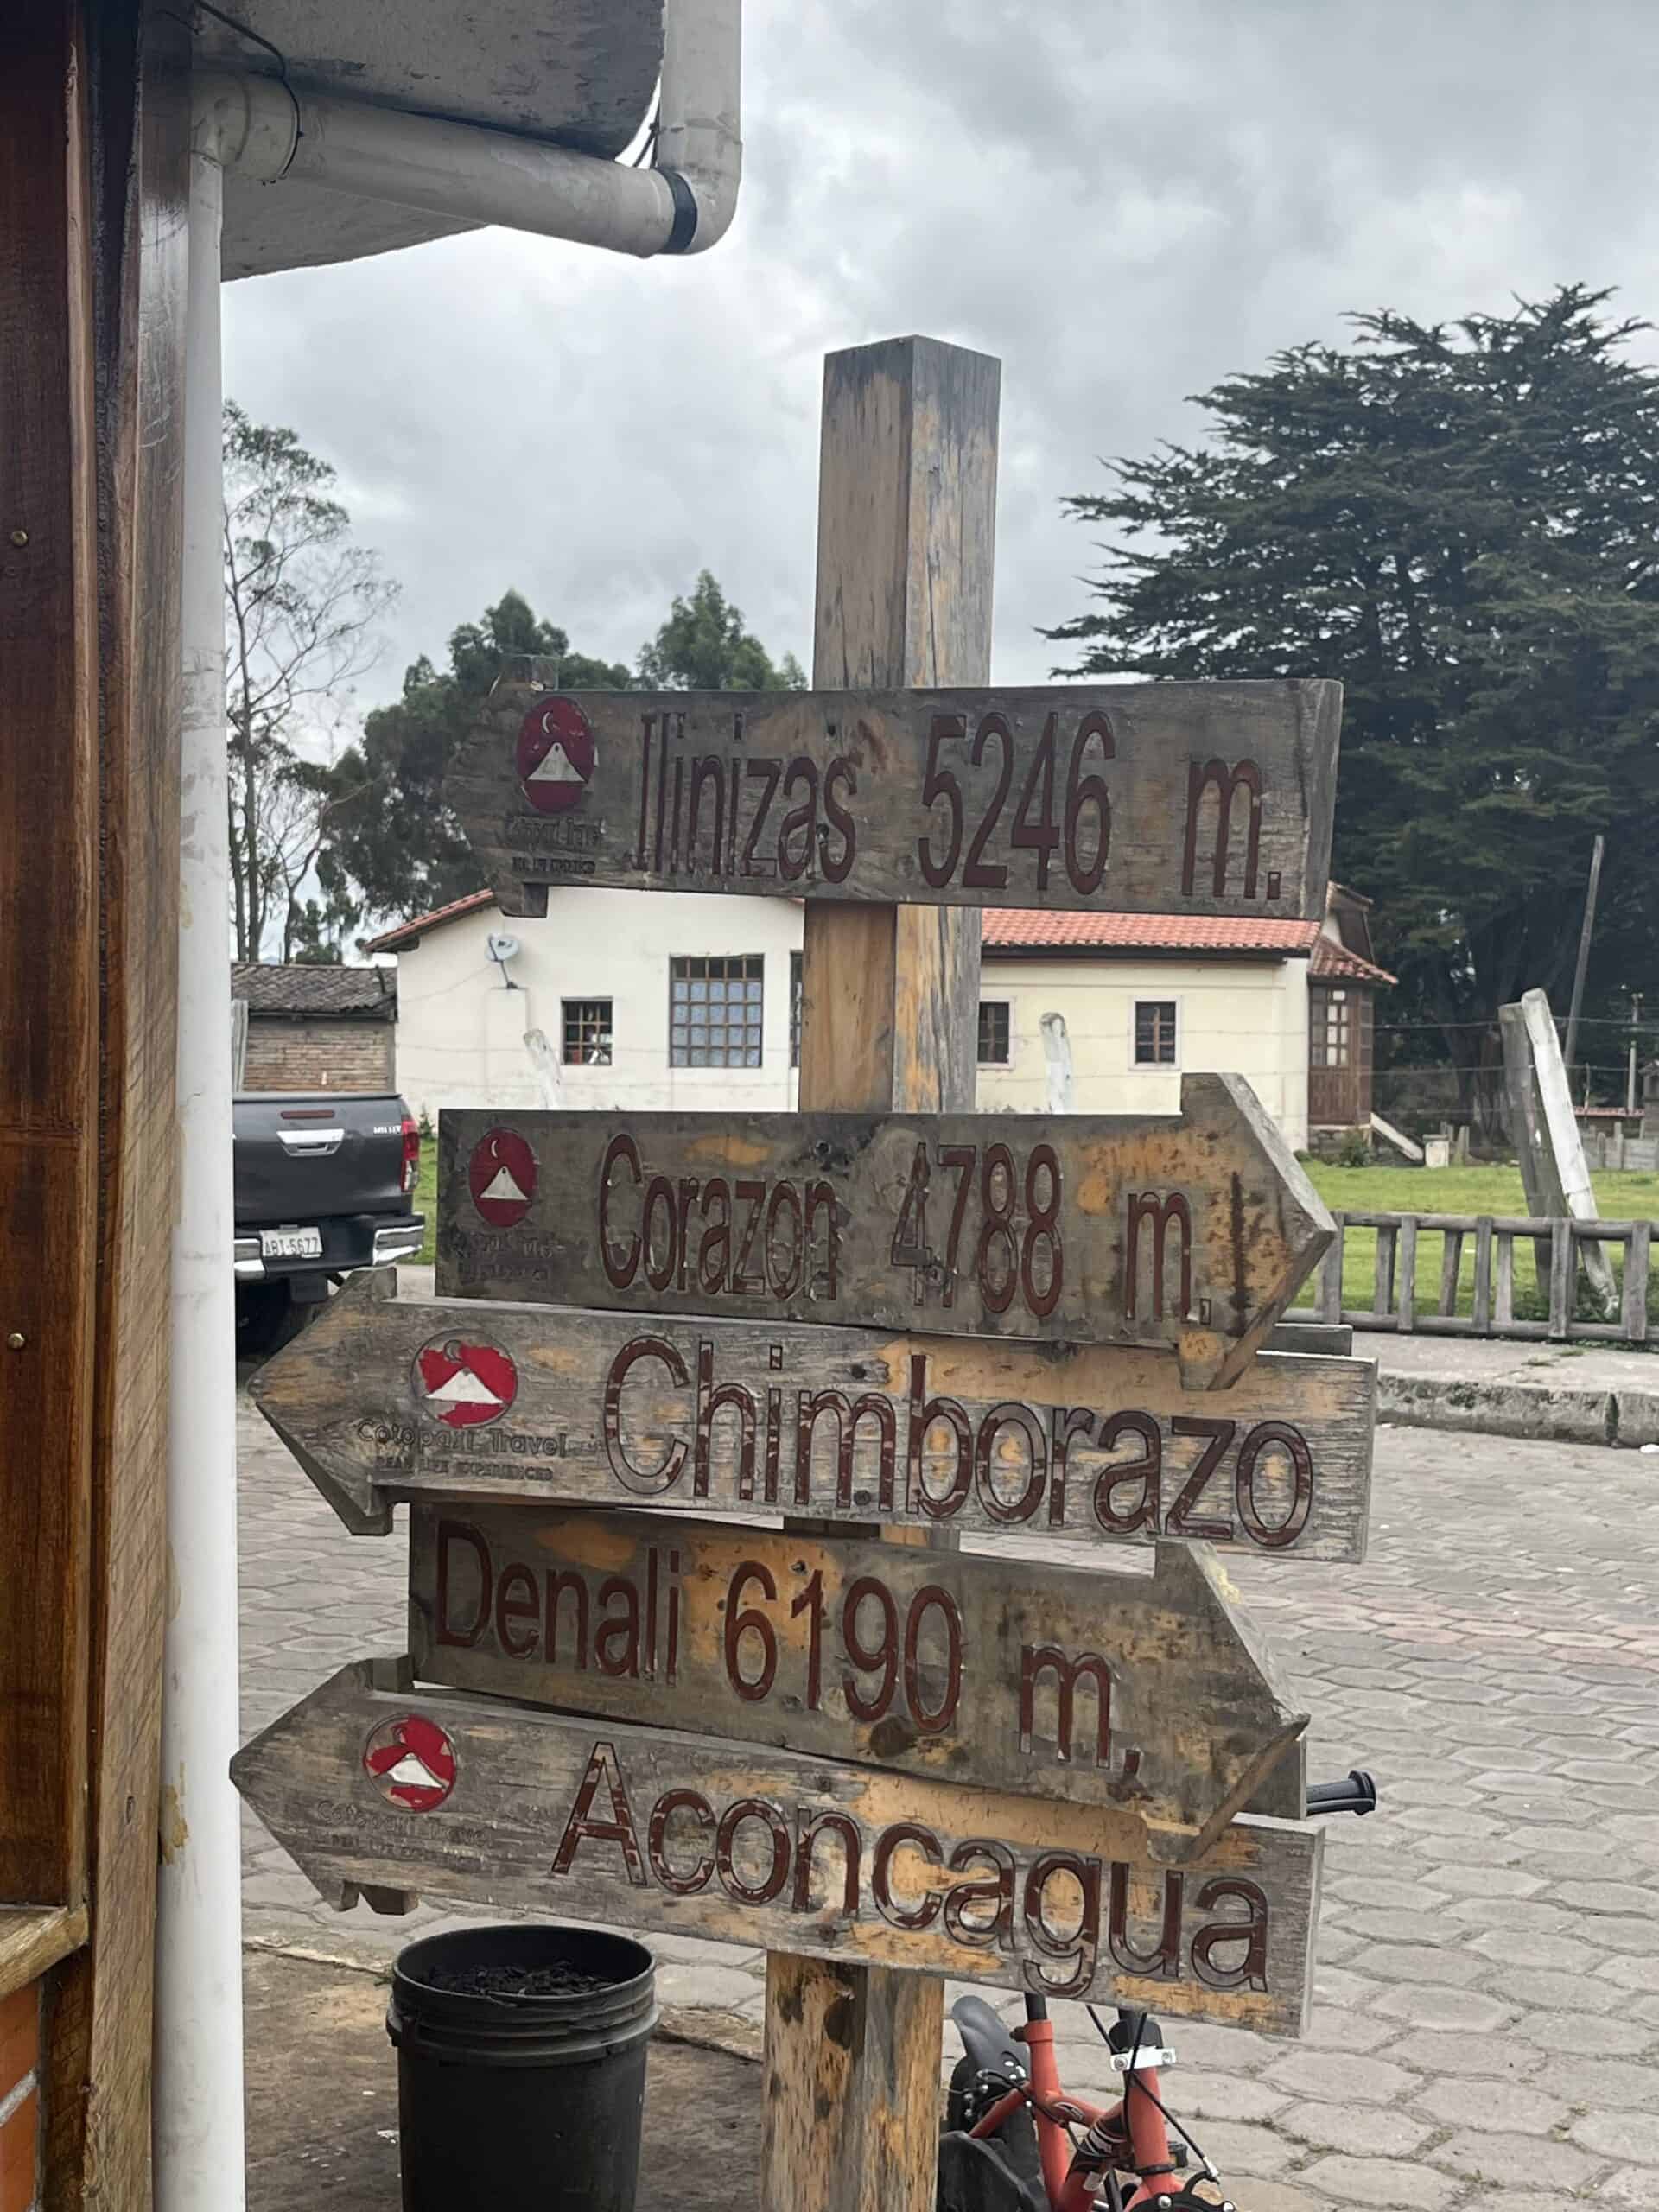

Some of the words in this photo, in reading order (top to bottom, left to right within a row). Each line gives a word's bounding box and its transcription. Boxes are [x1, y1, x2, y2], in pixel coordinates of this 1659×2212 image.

[630, 711, 857, 884] Ilinizas
[918, 711, 1116, 895] 5246
[599, 1133, 840, 1301] Corazon
[891, 1142, 1064, 1317] 4788
[489, 1427, 567, 1459] Travel
[605, 1335, 1313, 1547] Chimborazo
[436, 1520, 679, 1688] Denali
[724, 1560, 962, 1732] 6190
[551, 1742, 1268, 1999] Aconcagua
